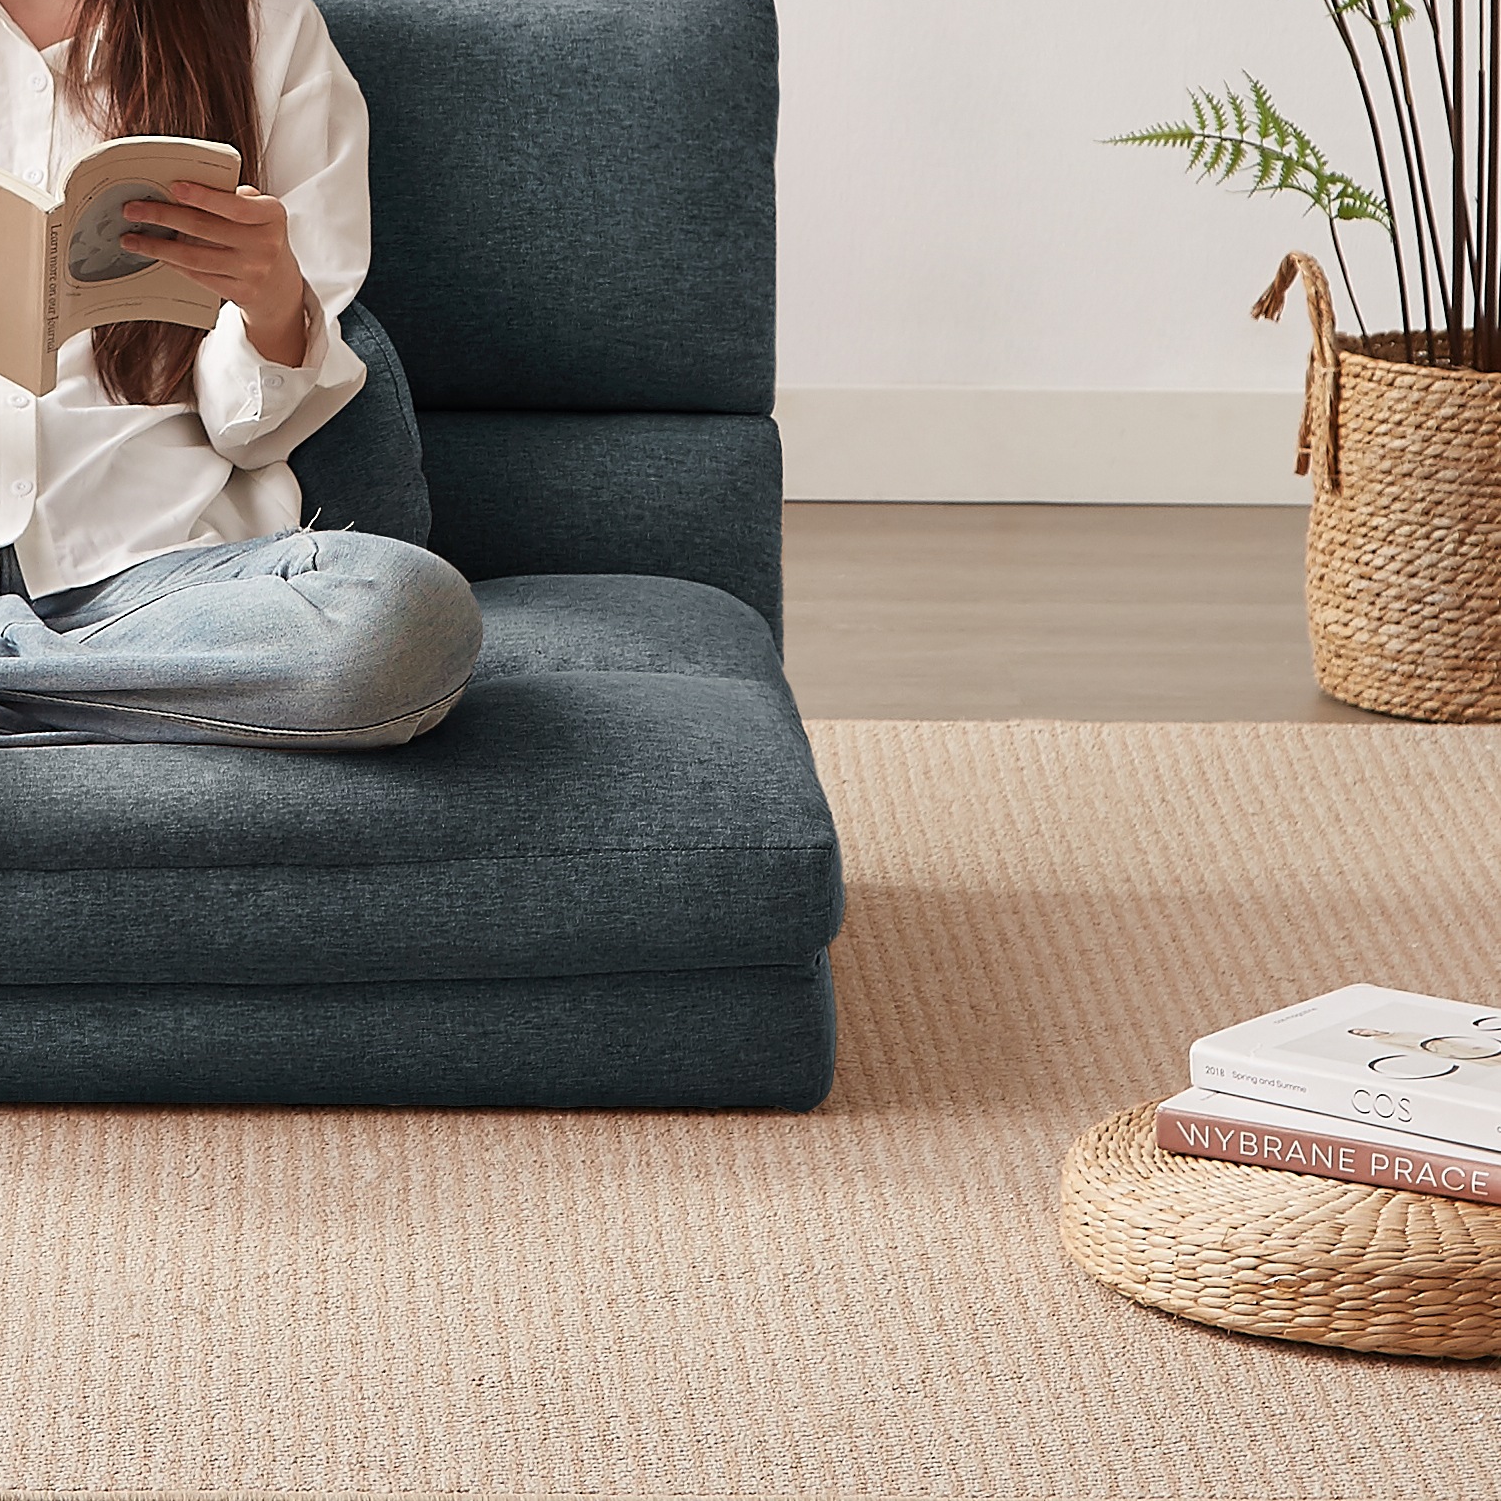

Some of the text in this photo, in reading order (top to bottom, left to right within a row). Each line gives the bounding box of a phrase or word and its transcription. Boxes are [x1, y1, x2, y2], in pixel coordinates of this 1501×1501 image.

[50, 223, 62, 255] Learn
[49, 255, 58, 282] more
[48, 282, 58, 297] on
[48, 298, 56, 314] our
[1205, 1065, 1225, 1077] 2018
[1232, 1070, 1258, 1085] Spring
[1259, 1077, 1275, 1087] and
[1351, 1089, 1413, 1123] COS
[1176, 1120, 1491, 1196] WYBRANE PRACE
